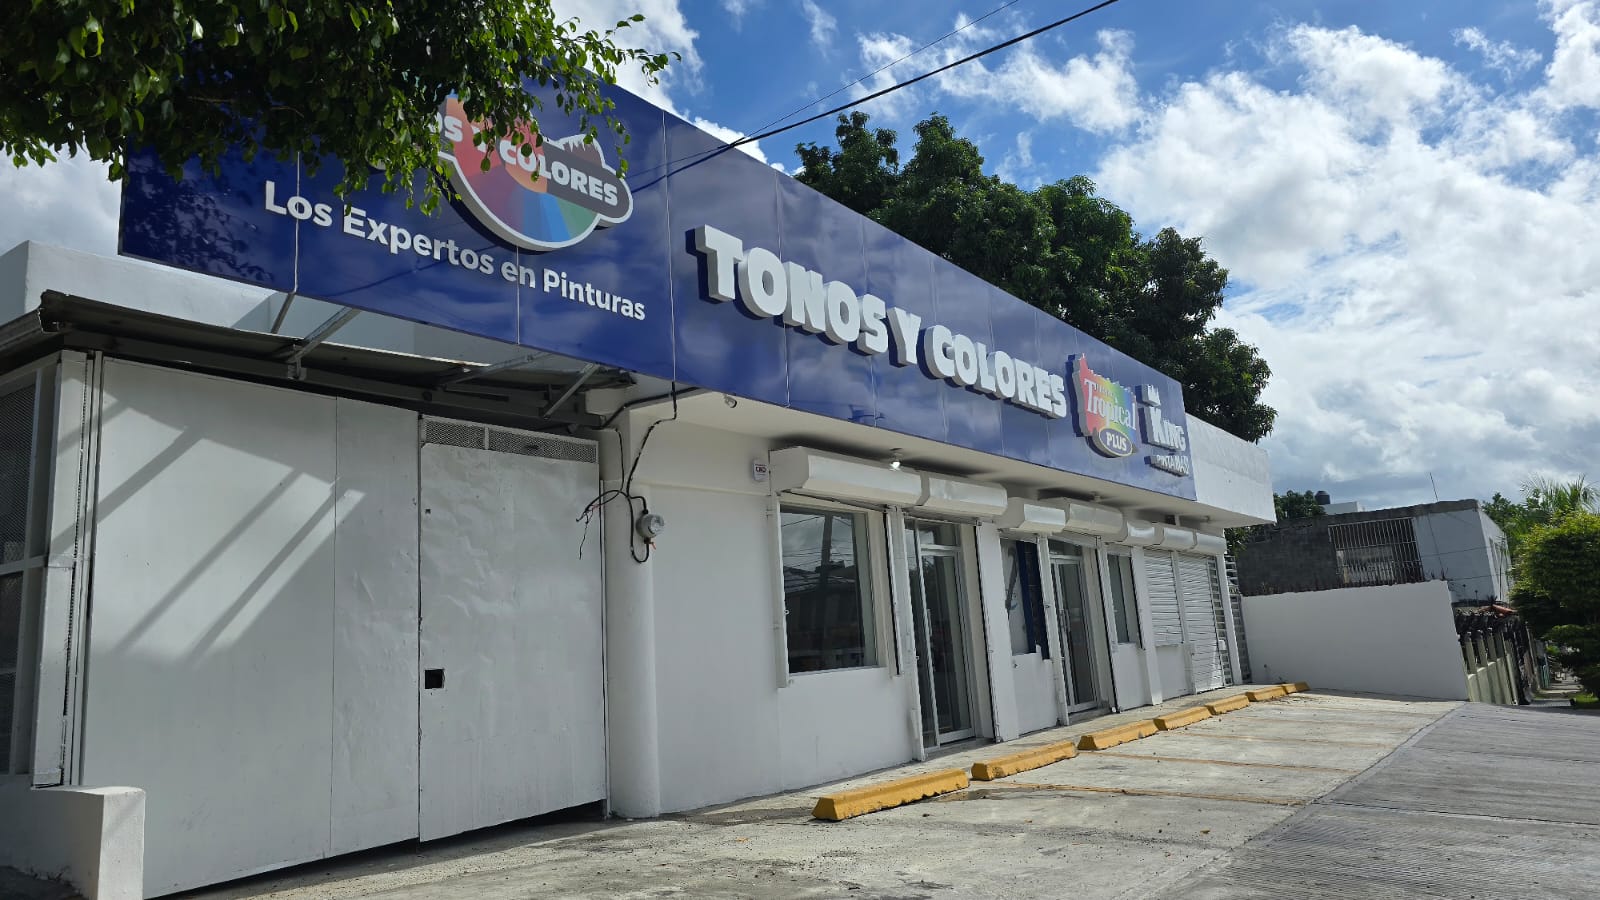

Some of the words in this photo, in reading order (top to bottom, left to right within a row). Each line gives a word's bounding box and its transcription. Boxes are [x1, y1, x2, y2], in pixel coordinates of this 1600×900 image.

[500, 140, 618, 206] COLORES
[265, 180, 333, 227] Los
[343, 204, 494, 275] Expertos
[501, 261, 535, 288] en
[543, 268, 645, 321] Pinturas
[697, 224, 888, 353] TONOS
[888, 306, 921, 365] Y
[925, 325, 1067, 418] COLORES
[1084, 378, 1136, 430] Tropical
[1106, 431, 1127, 451] PLUS
